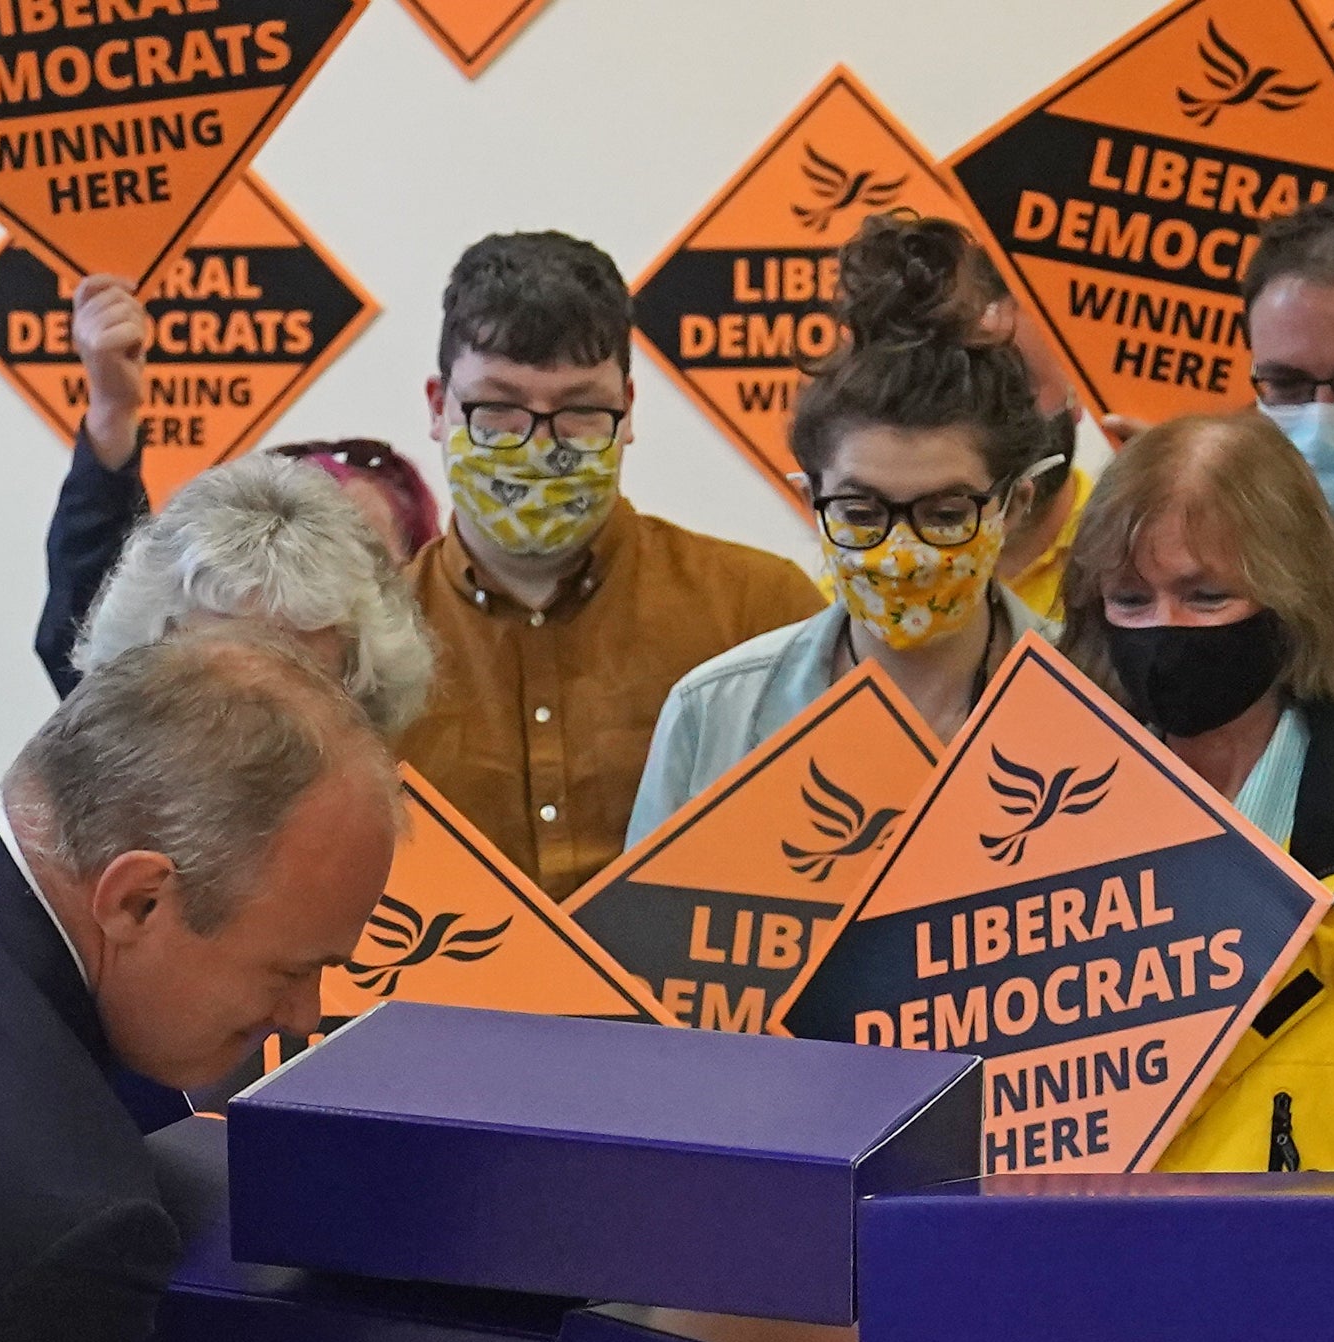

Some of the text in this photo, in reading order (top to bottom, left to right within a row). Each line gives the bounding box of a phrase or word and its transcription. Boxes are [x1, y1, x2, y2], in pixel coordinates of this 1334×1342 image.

[49, 166, 172, 215] HERE
[1013, 189, 1261, 284] DEMOC
[733, 257, 841, 303] LIBE
[7, 309, 315, 356] DECRATS
[62, 376, 251, 408] WNING
[1113, 338, 1232, 394] HERE
[141, 417, 205, 447] ERE
[915, 870, 1174, 980] LIBERAL
[854, 929, 1245, 1054] DEMOCRATS
[992, 1039, 1169, 1118] NNING
[985, 1108, 1110, 1177] HERE
